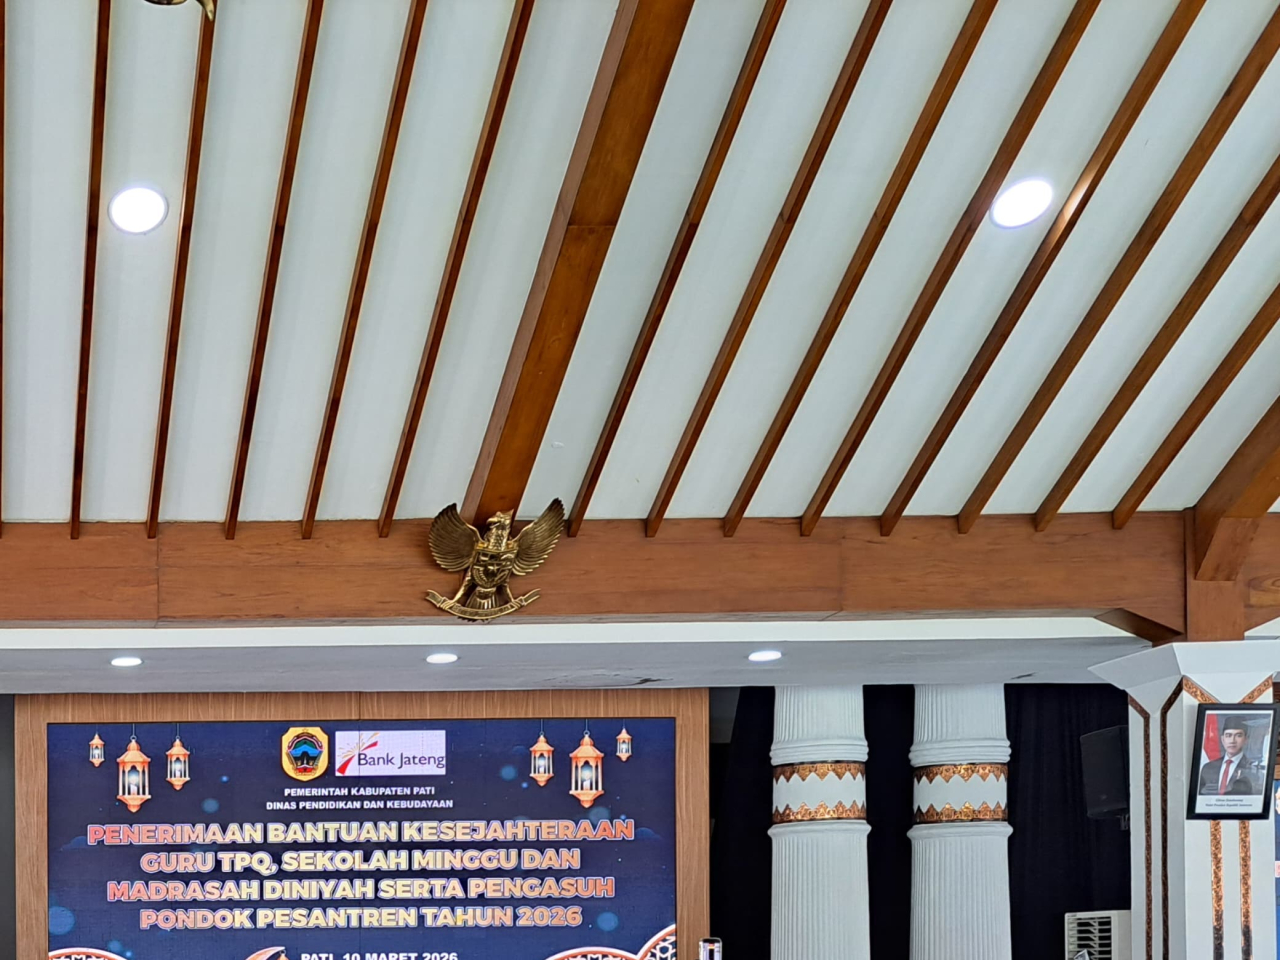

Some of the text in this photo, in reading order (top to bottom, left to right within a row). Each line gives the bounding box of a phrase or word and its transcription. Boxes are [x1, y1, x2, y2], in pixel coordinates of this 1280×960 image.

[358, 752, 446, 769] Bank Jateng
[284, 786, 435, 797] PEMERINTAH KABUPATEN PATI
[266, 800, 453, 810] DINAS PENDIDIKAN DAN KEBUDAYAAN
[87, 818, 635, 845] PENERIMAAN BANTUAN KESEJAHTERAAN
[140, 848, 581, 876] GURU TPQ, SEKOLAH MINGGU DAN
[107, 876, 615, 902] MADRASAH DINIYAH SERTA PENGASUH
[139, 905, 583, 930] PONDOK PESANTREN TAHUN 2026
